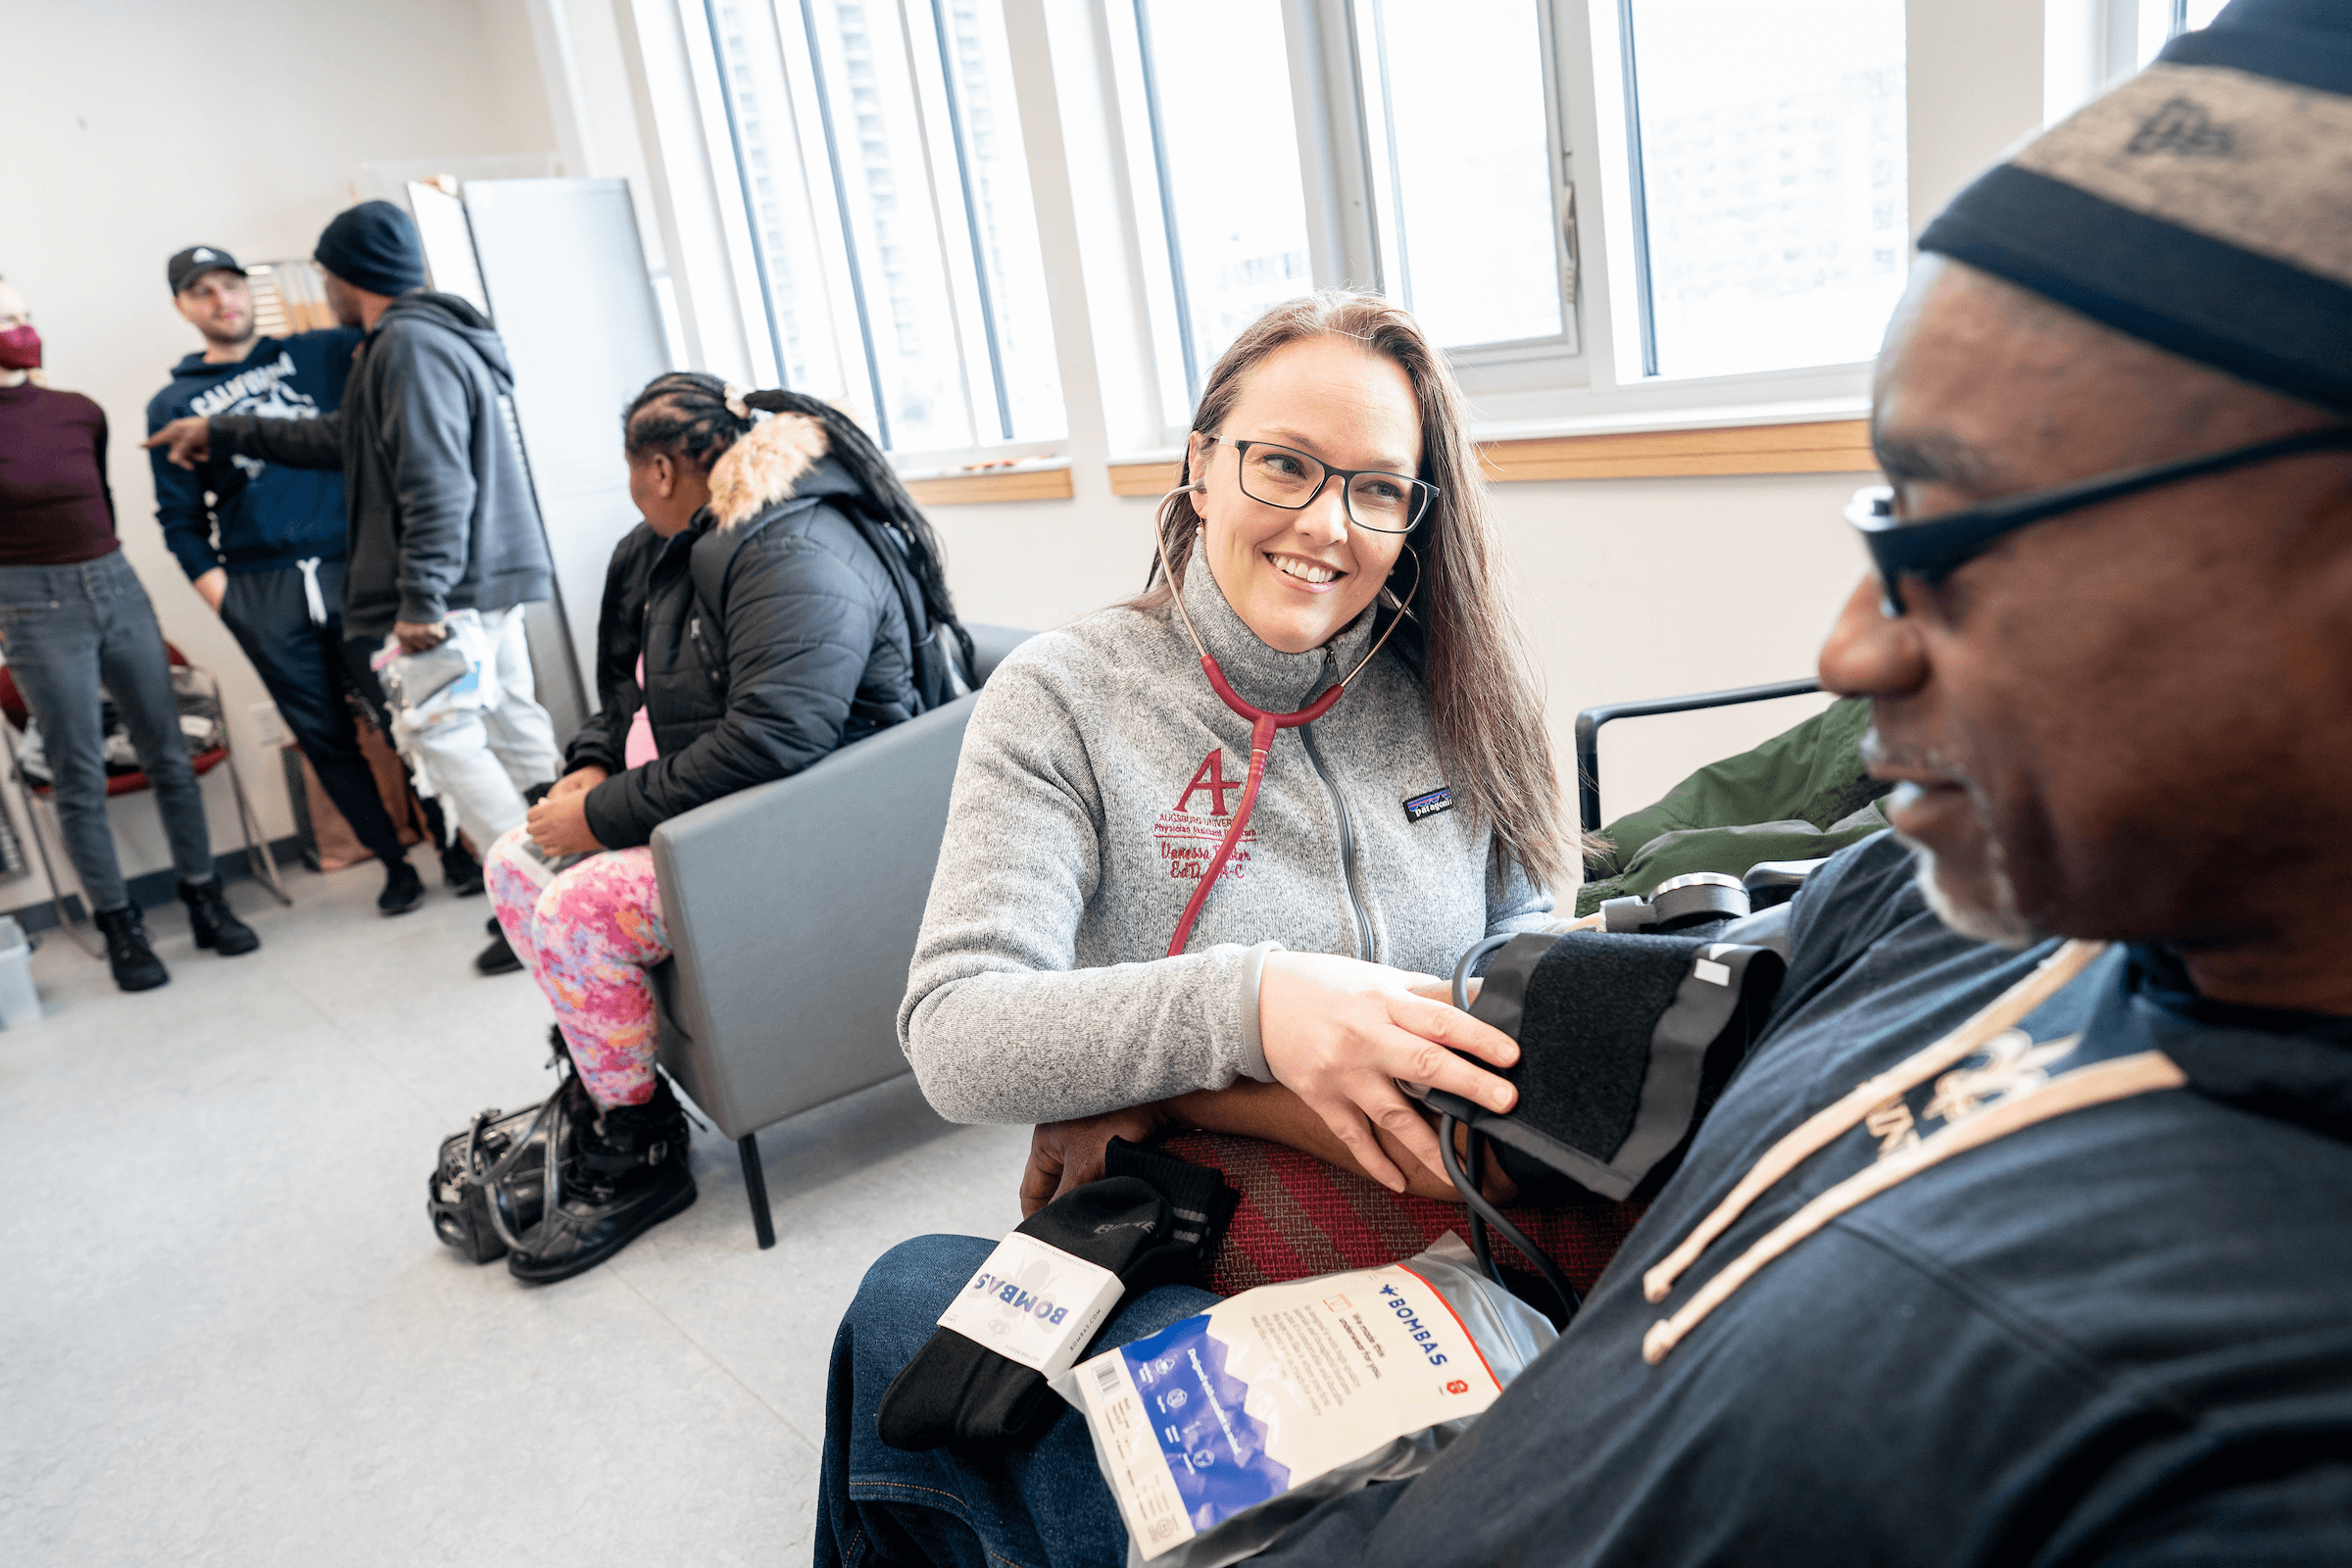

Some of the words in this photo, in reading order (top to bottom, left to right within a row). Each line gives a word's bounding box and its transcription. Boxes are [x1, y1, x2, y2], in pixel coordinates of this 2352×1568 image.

[1161, 841, 1209, 859] Vanessa
[973, 1273, 1069, 1326] BOMBAS
[1069, 1308, 1102, 1351] BOMBAS.COM
[1388, 1298, 1447, 1366] BOMBAS
